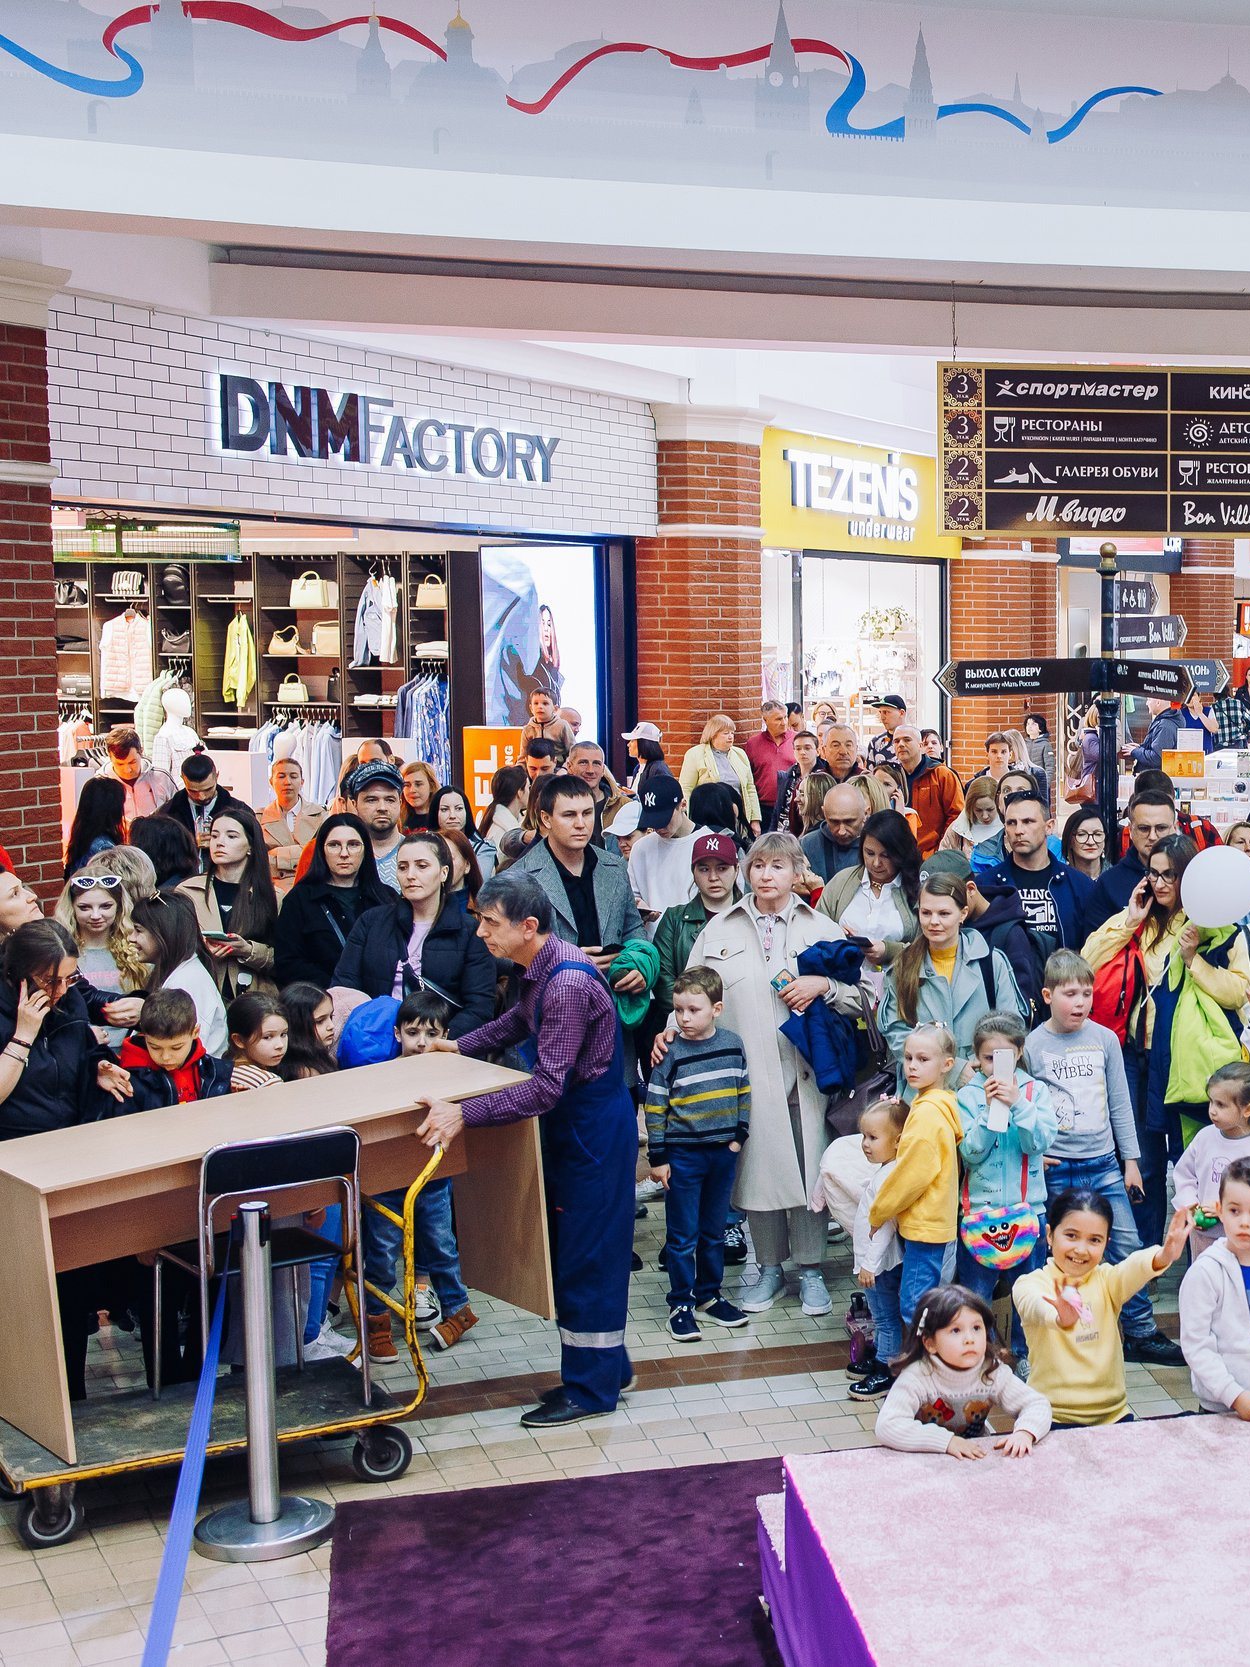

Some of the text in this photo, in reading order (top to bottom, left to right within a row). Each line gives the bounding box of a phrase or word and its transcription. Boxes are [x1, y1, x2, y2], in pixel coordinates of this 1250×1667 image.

[957, 375, 968, 394] 3
[957, 416, 968, 434] 3
[1021, 419, 1102, 432] РЕСТОРАНЫ
[957, 457, 969, 475] 2
[1055, 466, 1159, 478] ГАЛЕРЕЯ ОБУВИ
[957, 498, 969, 516] 2
[1025, 496, 1127, 528] М.видео
[1183, 501, 1216, 525] Bon
[848, 518, 915, 541] underwear
[965, 667, 1041, 679] ВЫХОД К СКВЕРУ
[970, 682, 1000, 690] монументу
[1052, 1056, 1090, 1069] BIG CITY
[1052, 1064, 1093, 1080] VIBES
